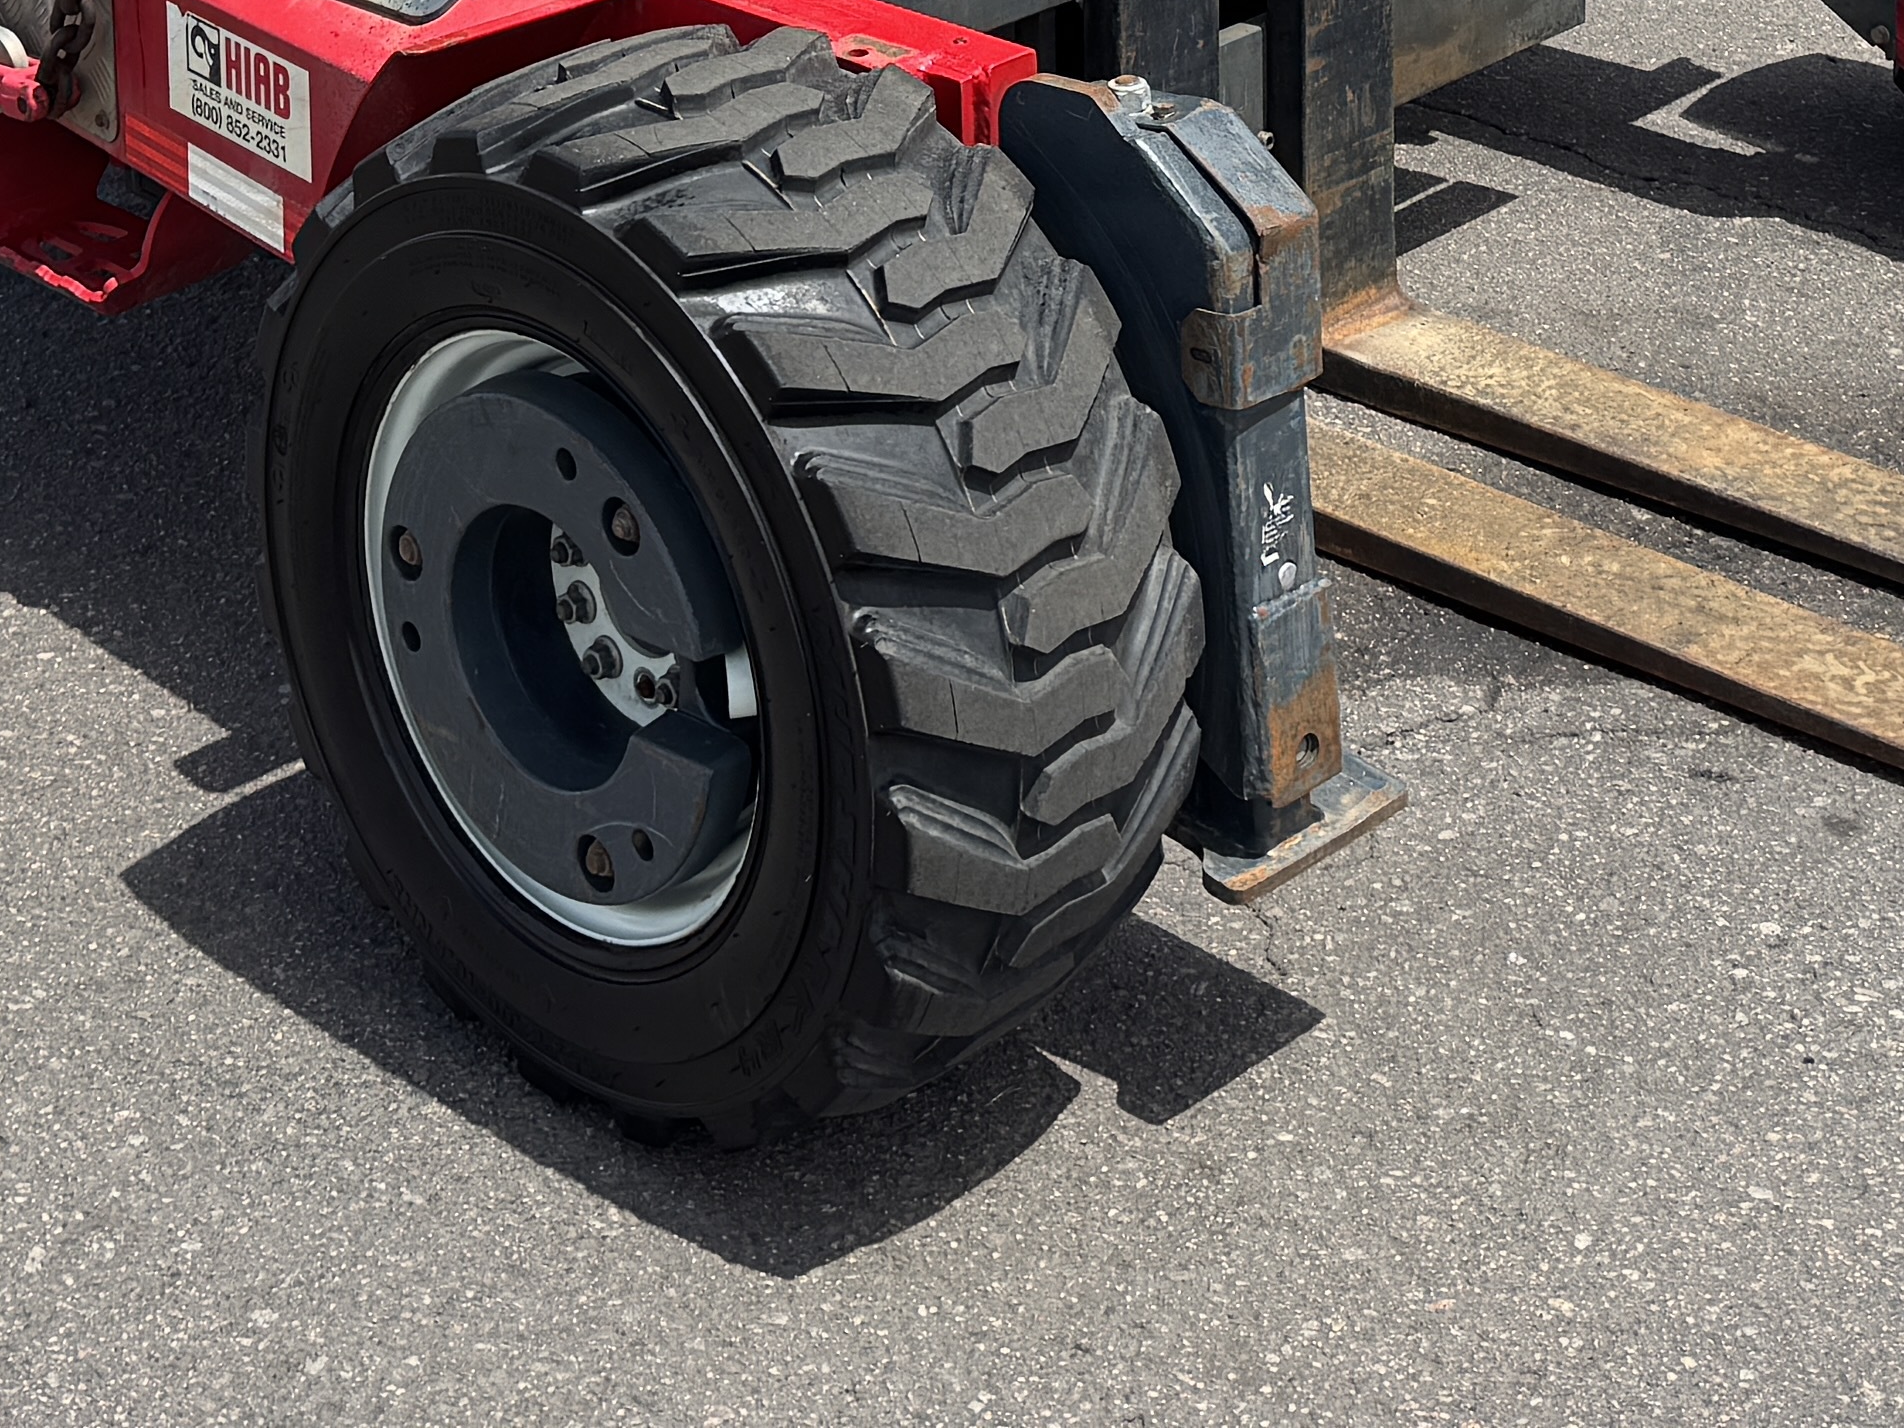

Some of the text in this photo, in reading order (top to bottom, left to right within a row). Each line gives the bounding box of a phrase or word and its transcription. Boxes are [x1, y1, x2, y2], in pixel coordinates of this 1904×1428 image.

[191, 78, 287, 139] SALES AND SERVICE
[225, 36, 291, 120] HIAB
[191, 94, 287, 163] (800) 852-2331
